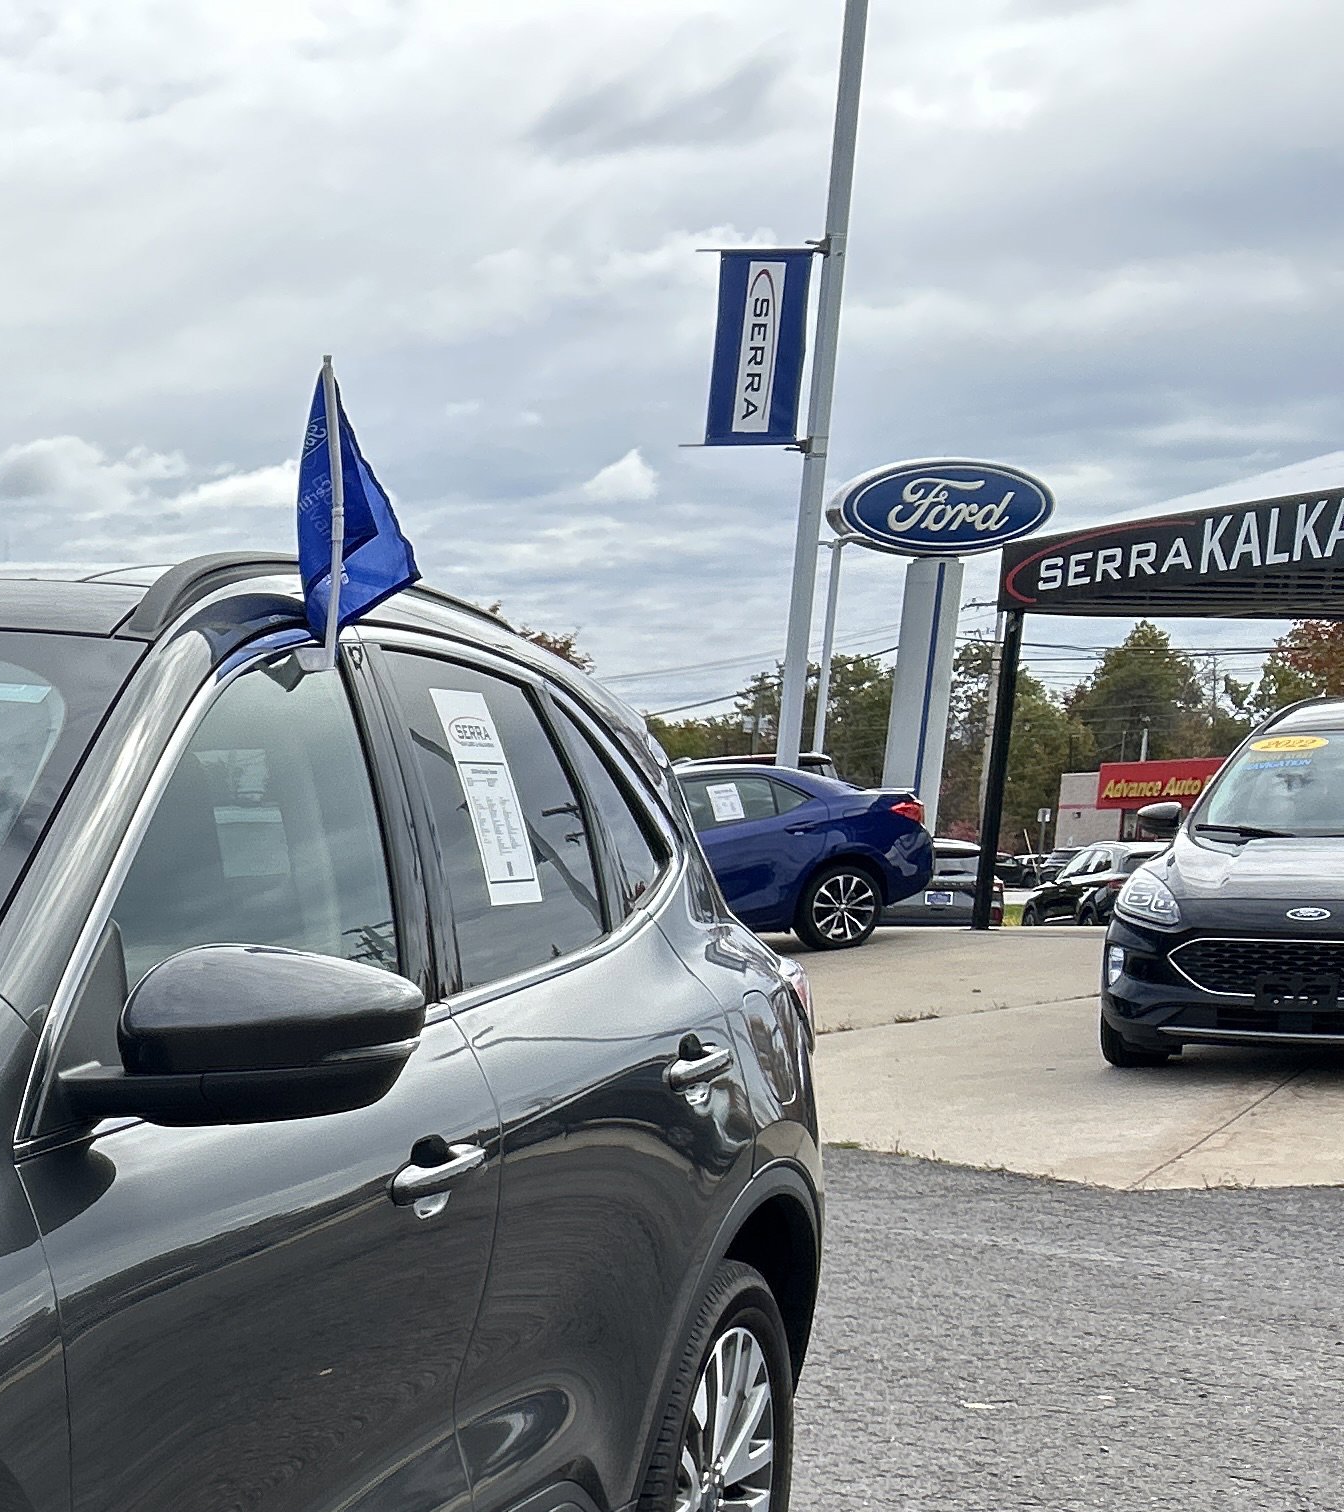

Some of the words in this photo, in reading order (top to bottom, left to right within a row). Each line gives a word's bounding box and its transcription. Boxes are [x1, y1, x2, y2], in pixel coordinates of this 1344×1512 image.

[740, 297, 770, 421] SERRA
[886, 477, 1016, 532] Ford
[1037, 537, 1192, 591] SERRA
[454, 724, 492, 741] SERRA
[1102, 778, 1161, 798] Advance
[1163, 776, 1202, 797] Auto
